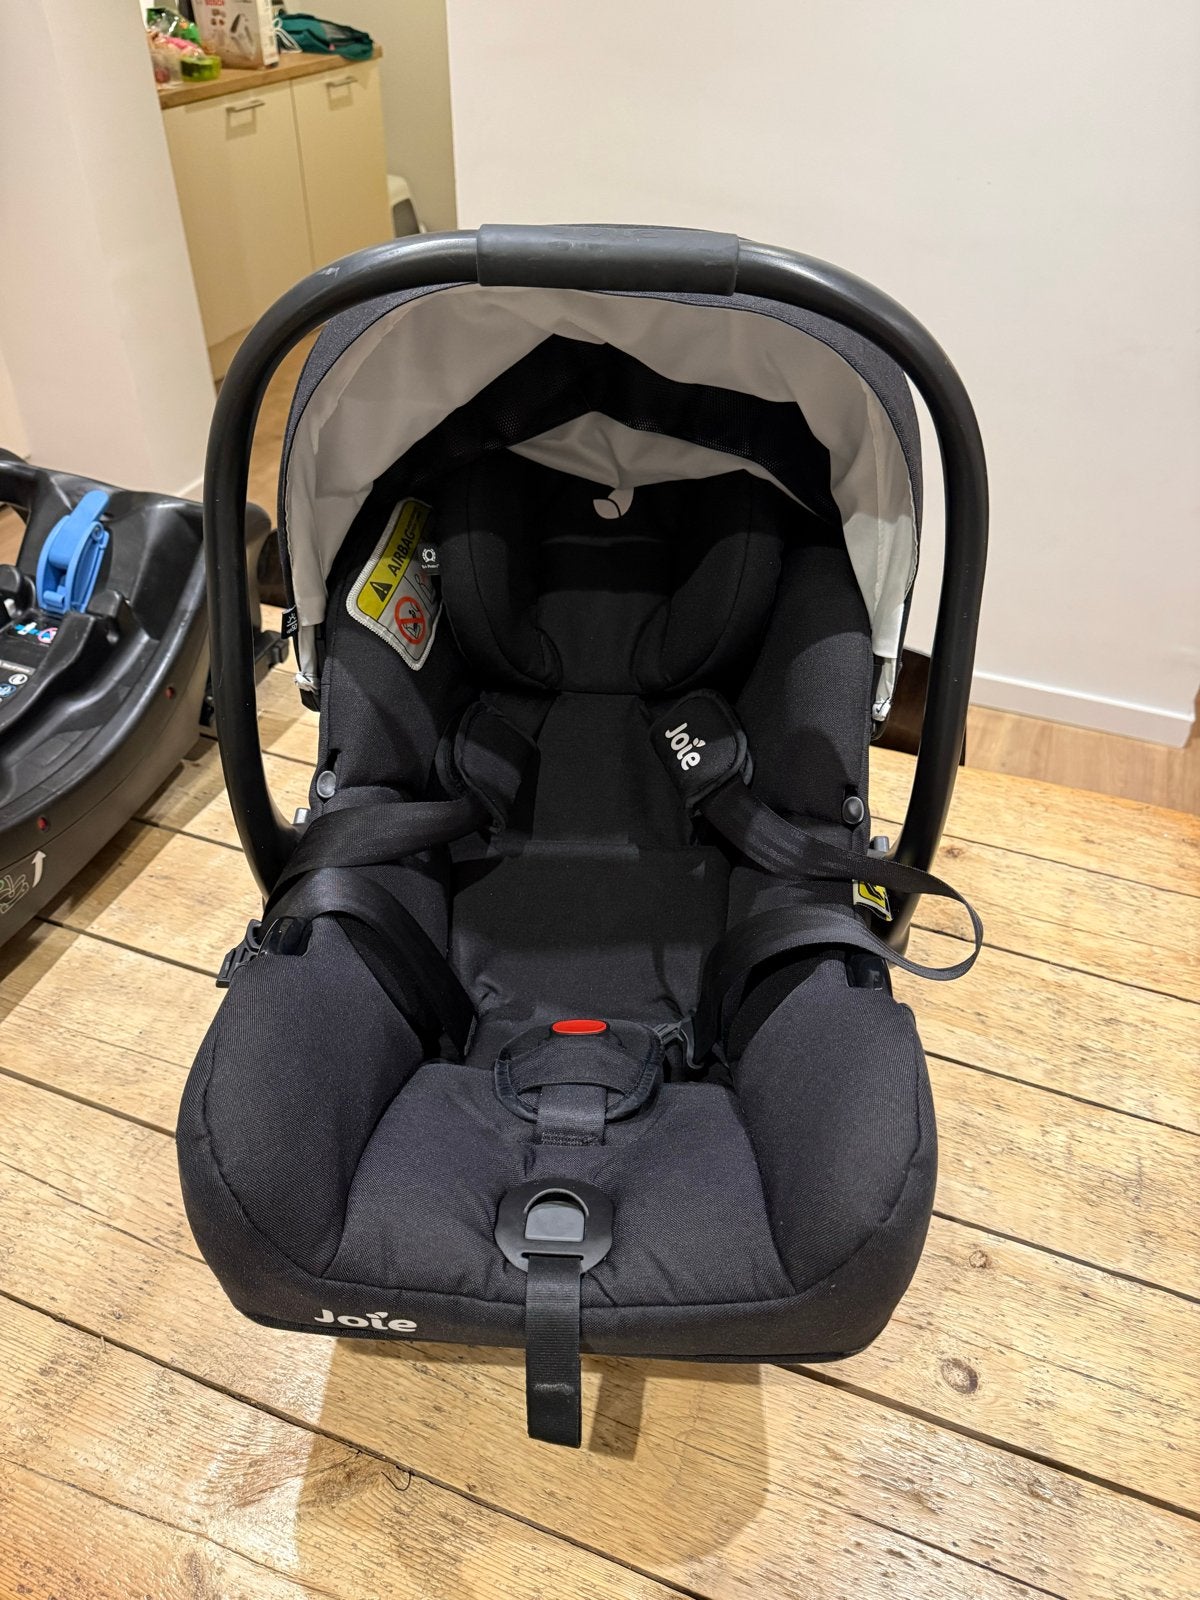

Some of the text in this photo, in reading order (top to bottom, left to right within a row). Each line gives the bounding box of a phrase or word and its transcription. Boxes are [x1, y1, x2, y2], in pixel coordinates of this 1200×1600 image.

[387, 528, 416, 577] AIRBAG
[664, 722, 706, 771] Joie
[314, 1309, 418, 1332] Joie
